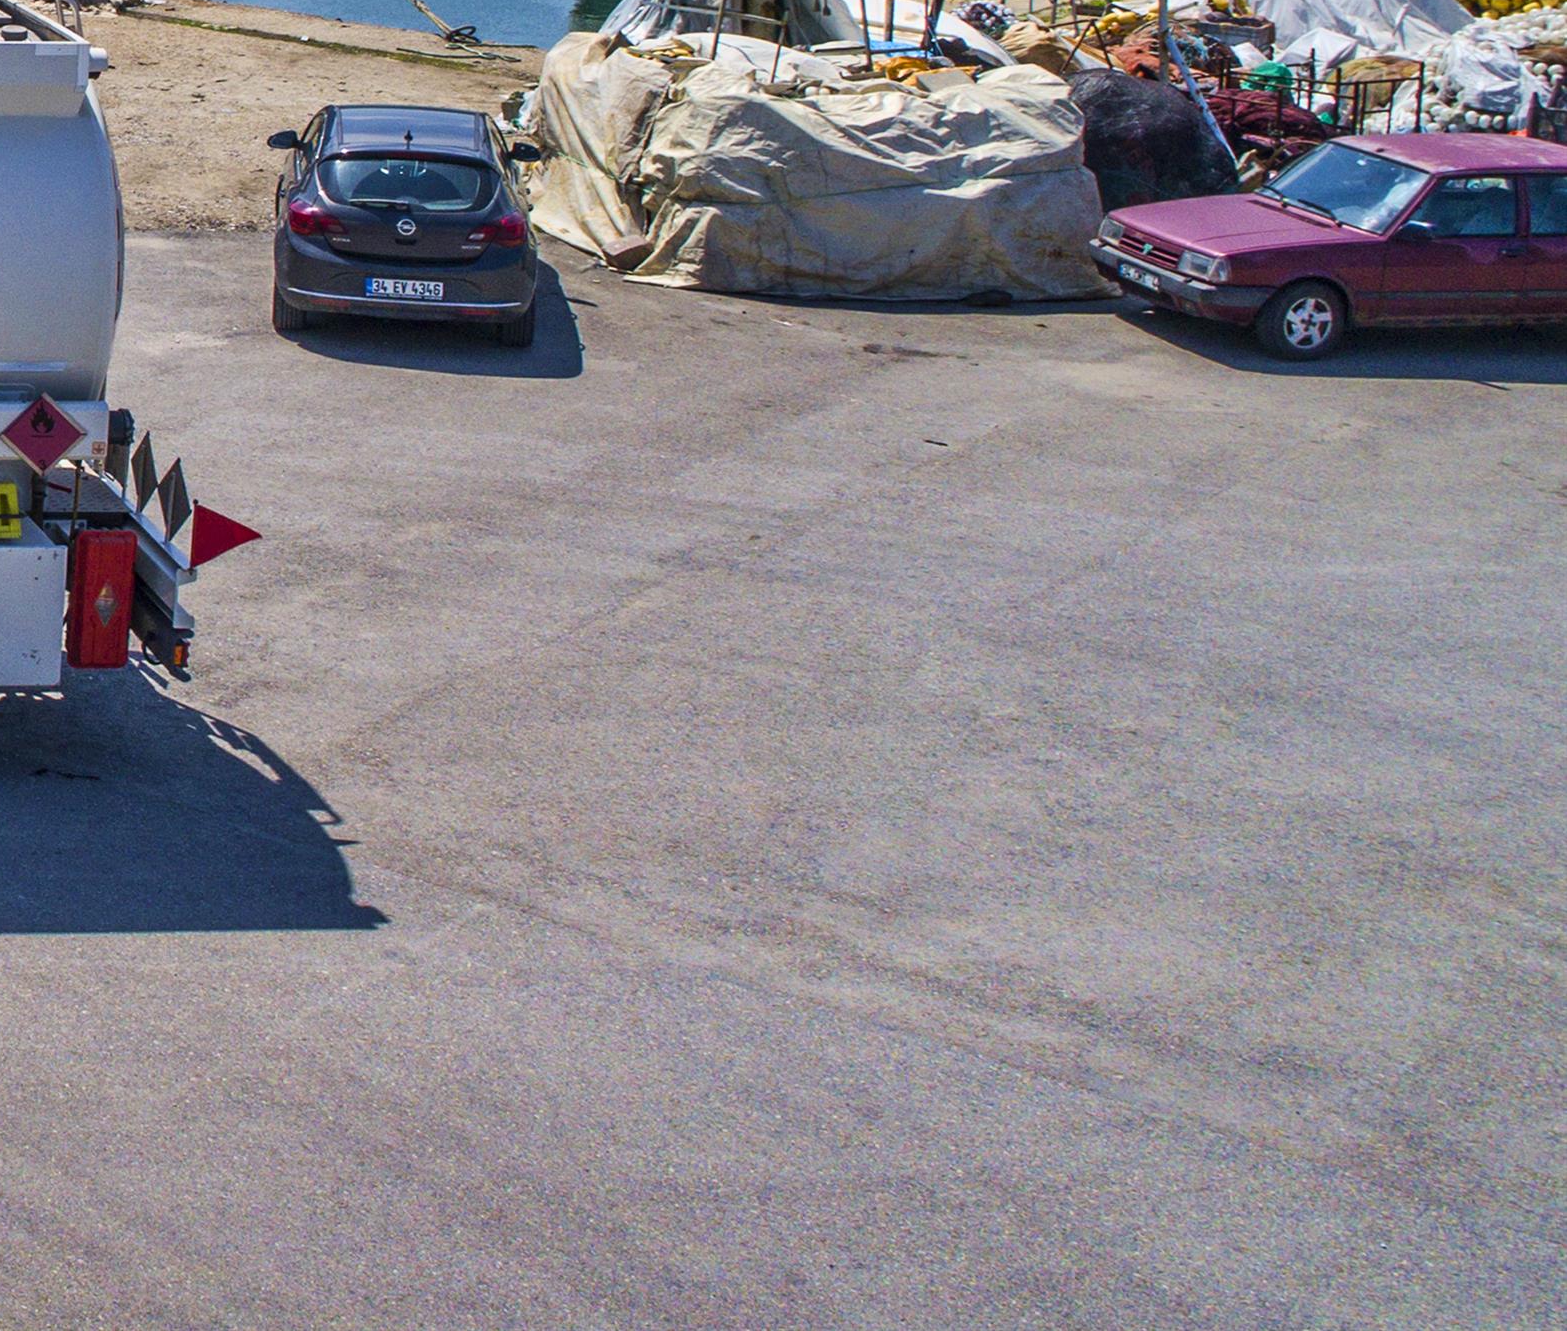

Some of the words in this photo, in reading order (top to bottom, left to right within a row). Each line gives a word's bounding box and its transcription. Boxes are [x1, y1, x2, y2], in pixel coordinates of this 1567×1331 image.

[373, 279, 388, 293] 34
[393, 280, 407, 294] EV
[411, 281, 441, 297] 4346
